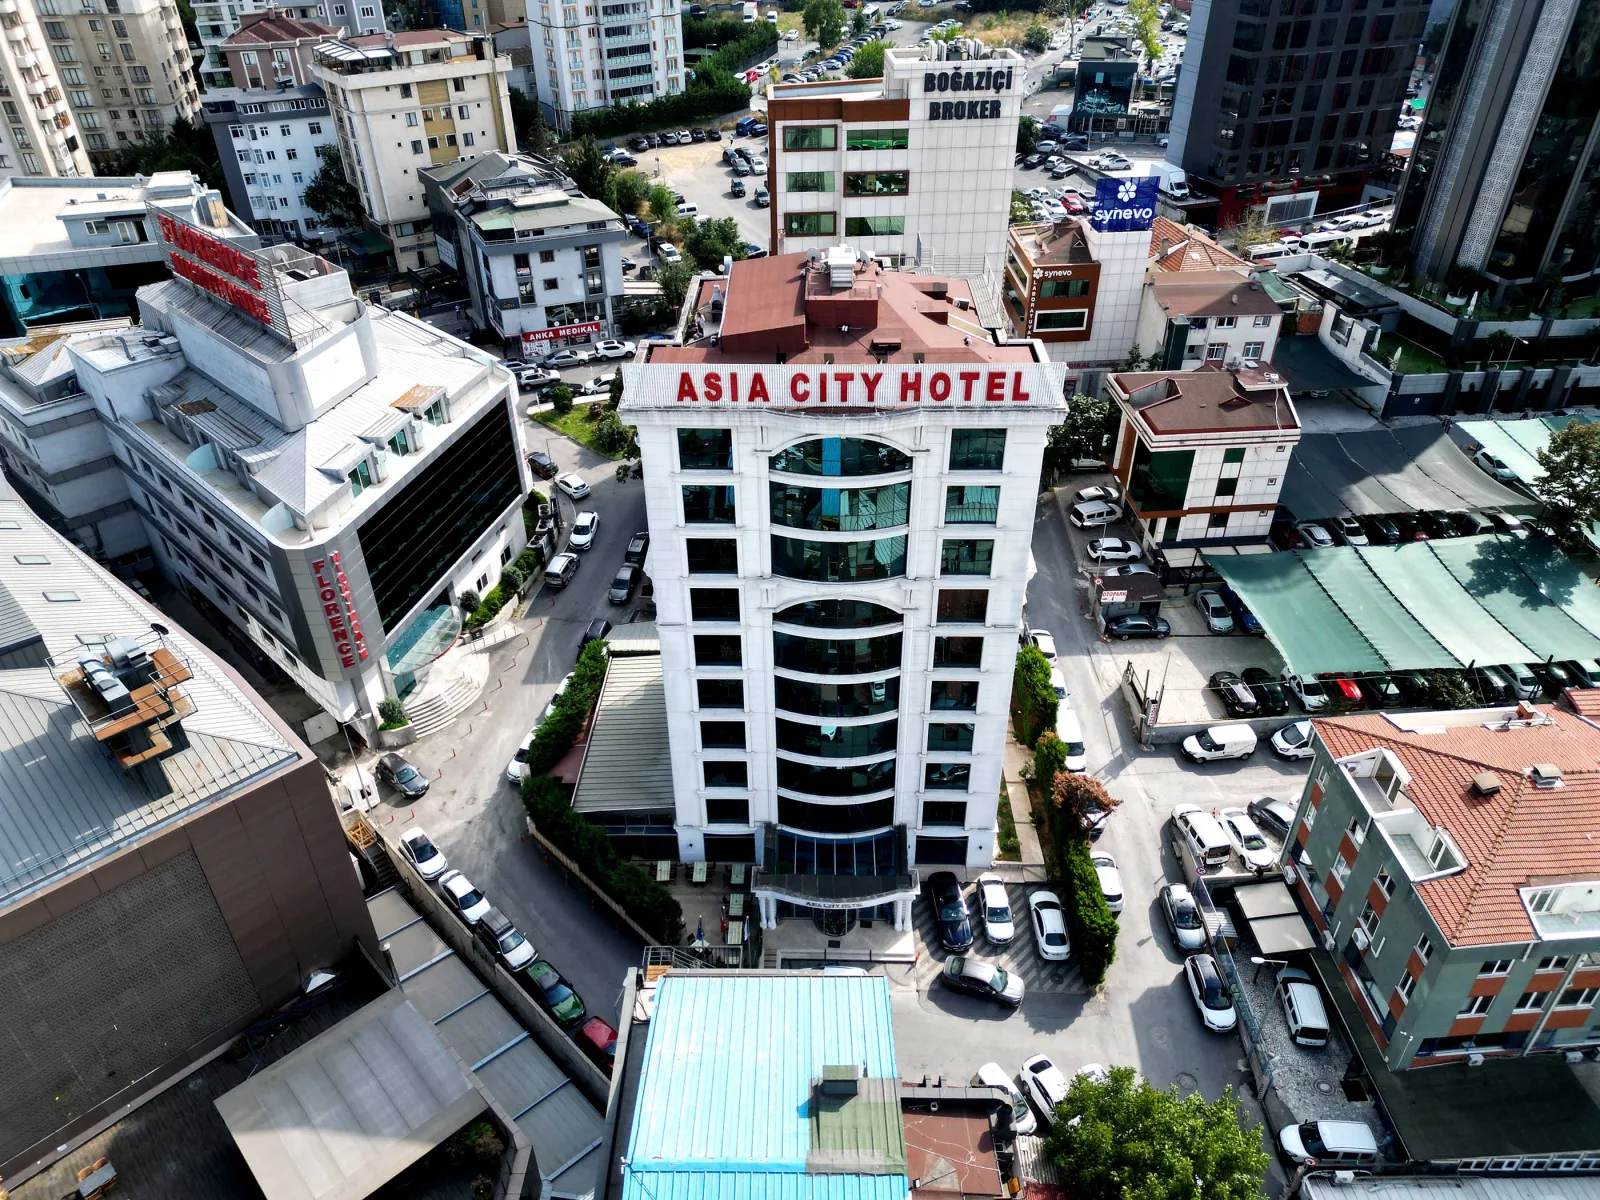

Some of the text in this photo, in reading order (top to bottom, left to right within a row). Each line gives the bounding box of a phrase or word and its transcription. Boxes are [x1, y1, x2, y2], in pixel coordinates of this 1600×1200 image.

[924, 66, 1012, 94] BOĞAZİÇİ
[929, 100, 1001, 120] BROKER
[1094, 207, 1153, 224] synevo
[1044, 270, 1072, 278] synevo
[529, 332, 554, 341] ANKA
[677, 371, 1030, 402] ASIA CITY HOTEL
[312, 559, 355, 669] FLORENCE
